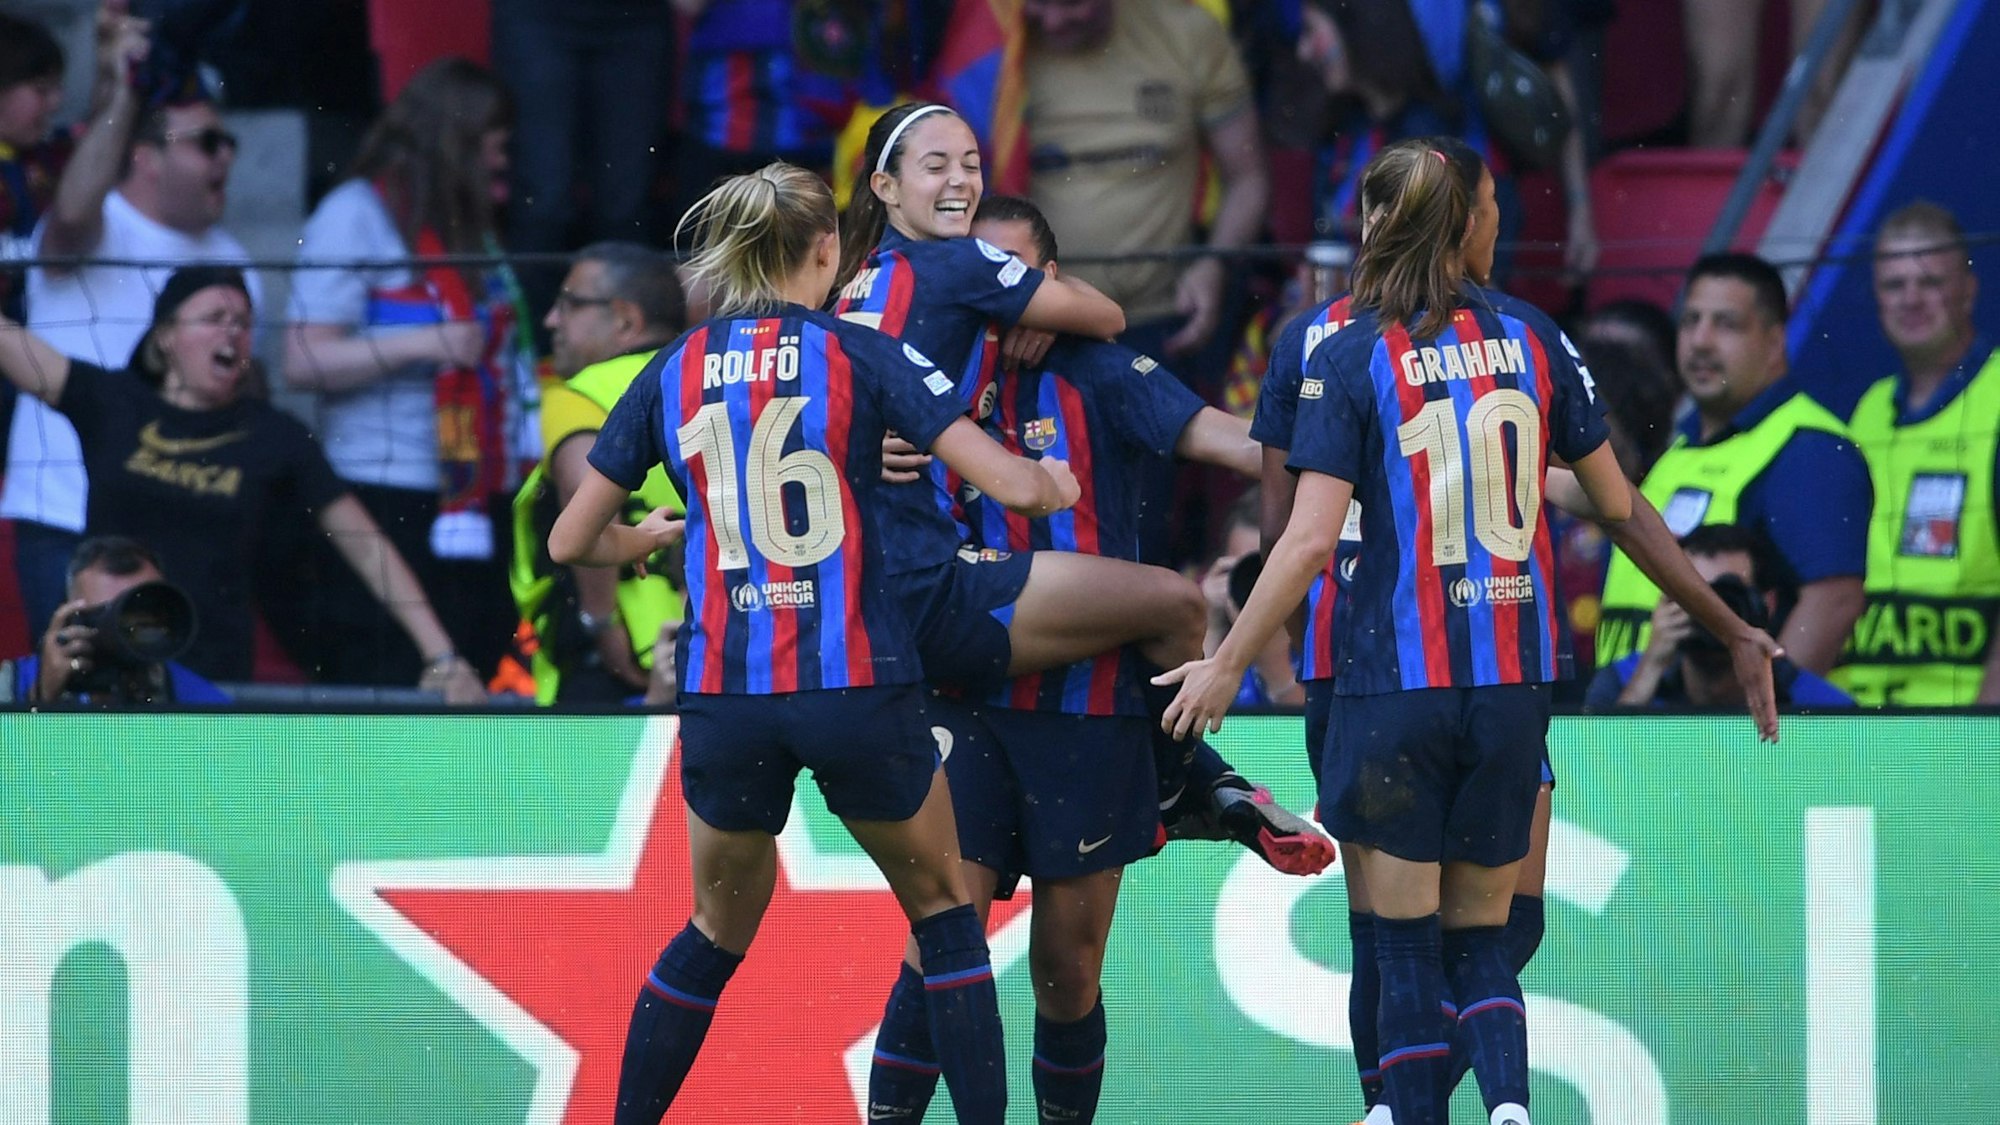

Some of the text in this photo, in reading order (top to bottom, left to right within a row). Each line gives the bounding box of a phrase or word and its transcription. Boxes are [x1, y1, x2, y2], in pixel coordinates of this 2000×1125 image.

[703, 336, 799, 390] ROLFÖ
[1400, 338, 1526, 387] GRAHAM
[676, 397, 847, 571] 16
[1396, 388, 1541, 567] 10
[761, 580, 813, 595] UNHCR
[1484, 574, 1532, 589] UNHCR
[1486, 586, 1534, 600] ACNUR
[765, 592, 815, 606] ACNUR
